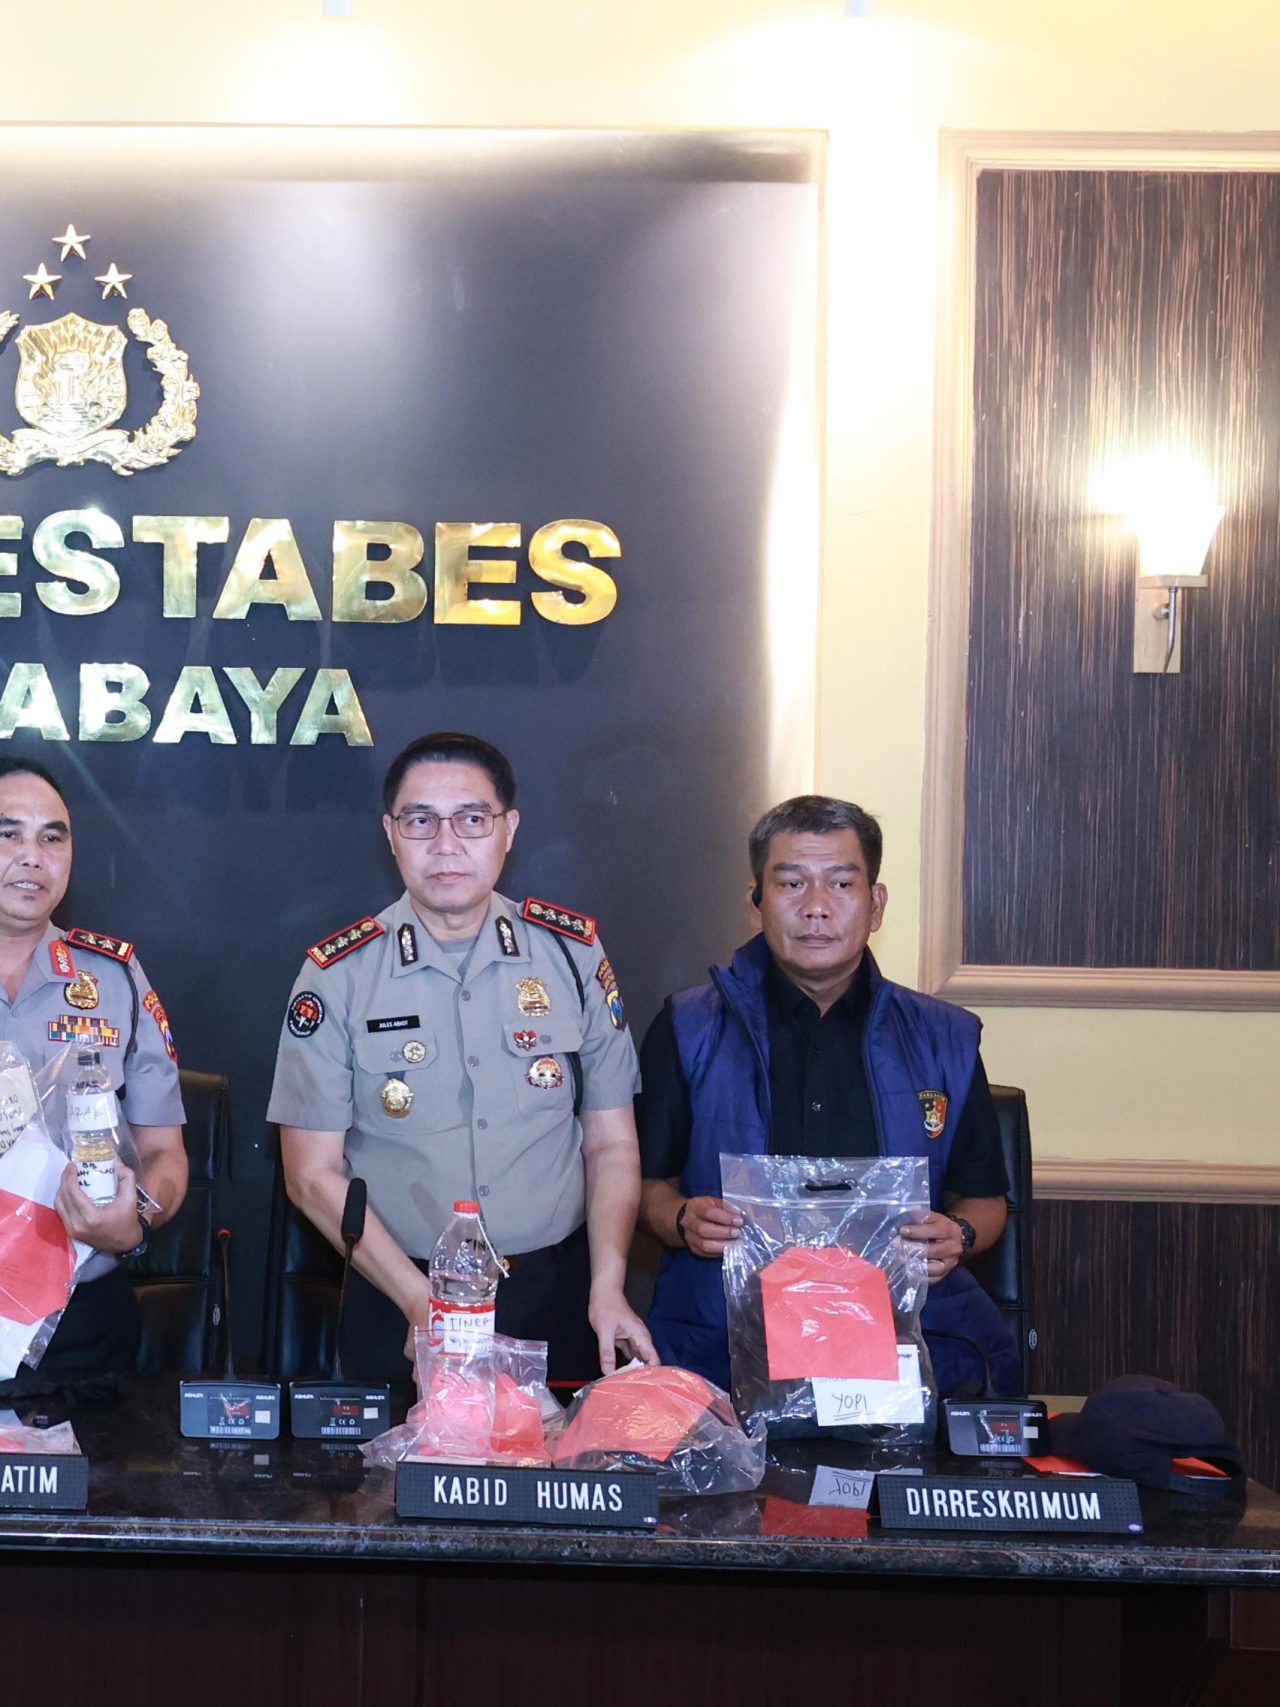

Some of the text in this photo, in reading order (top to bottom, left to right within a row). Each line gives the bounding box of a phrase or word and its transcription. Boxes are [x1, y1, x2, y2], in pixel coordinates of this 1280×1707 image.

[831, 1393, 868, 1414] YOPI
[434, 1475, 623, 1512] KABID HUMAS
[906, 1487, 1101, 1520] DIRRESKRIMUM
